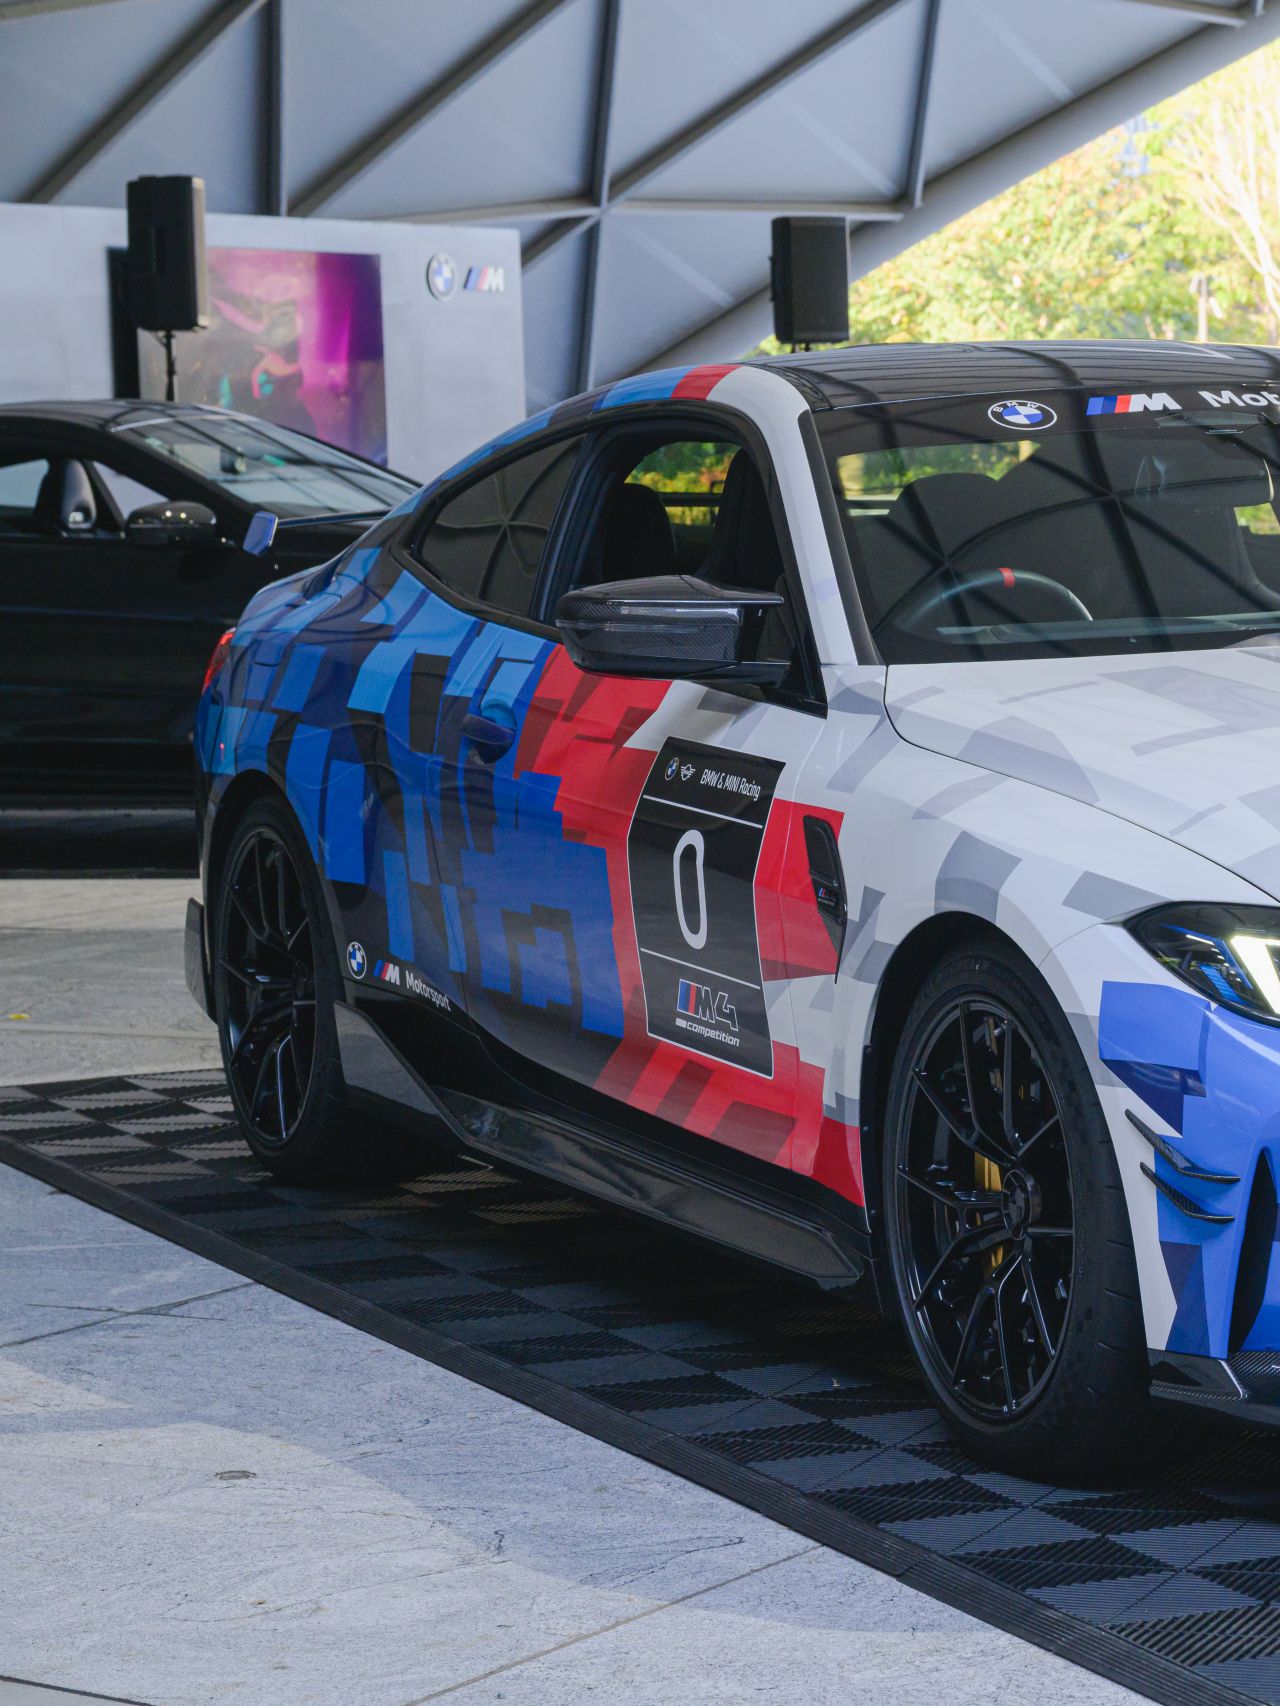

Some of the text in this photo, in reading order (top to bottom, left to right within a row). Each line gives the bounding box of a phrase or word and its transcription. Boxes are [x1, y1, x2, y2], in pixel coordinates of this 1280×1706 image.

[992, 401, 1040, 413] BMW
[700, 768, 761, 801] BMW & MINI Racing
[673, 829, 707, 950] 0
[405, 970, 451, 1012] Motorsport
[694, 983, 738, 1032] M4
[686, 1021, 740, 1047] competition
